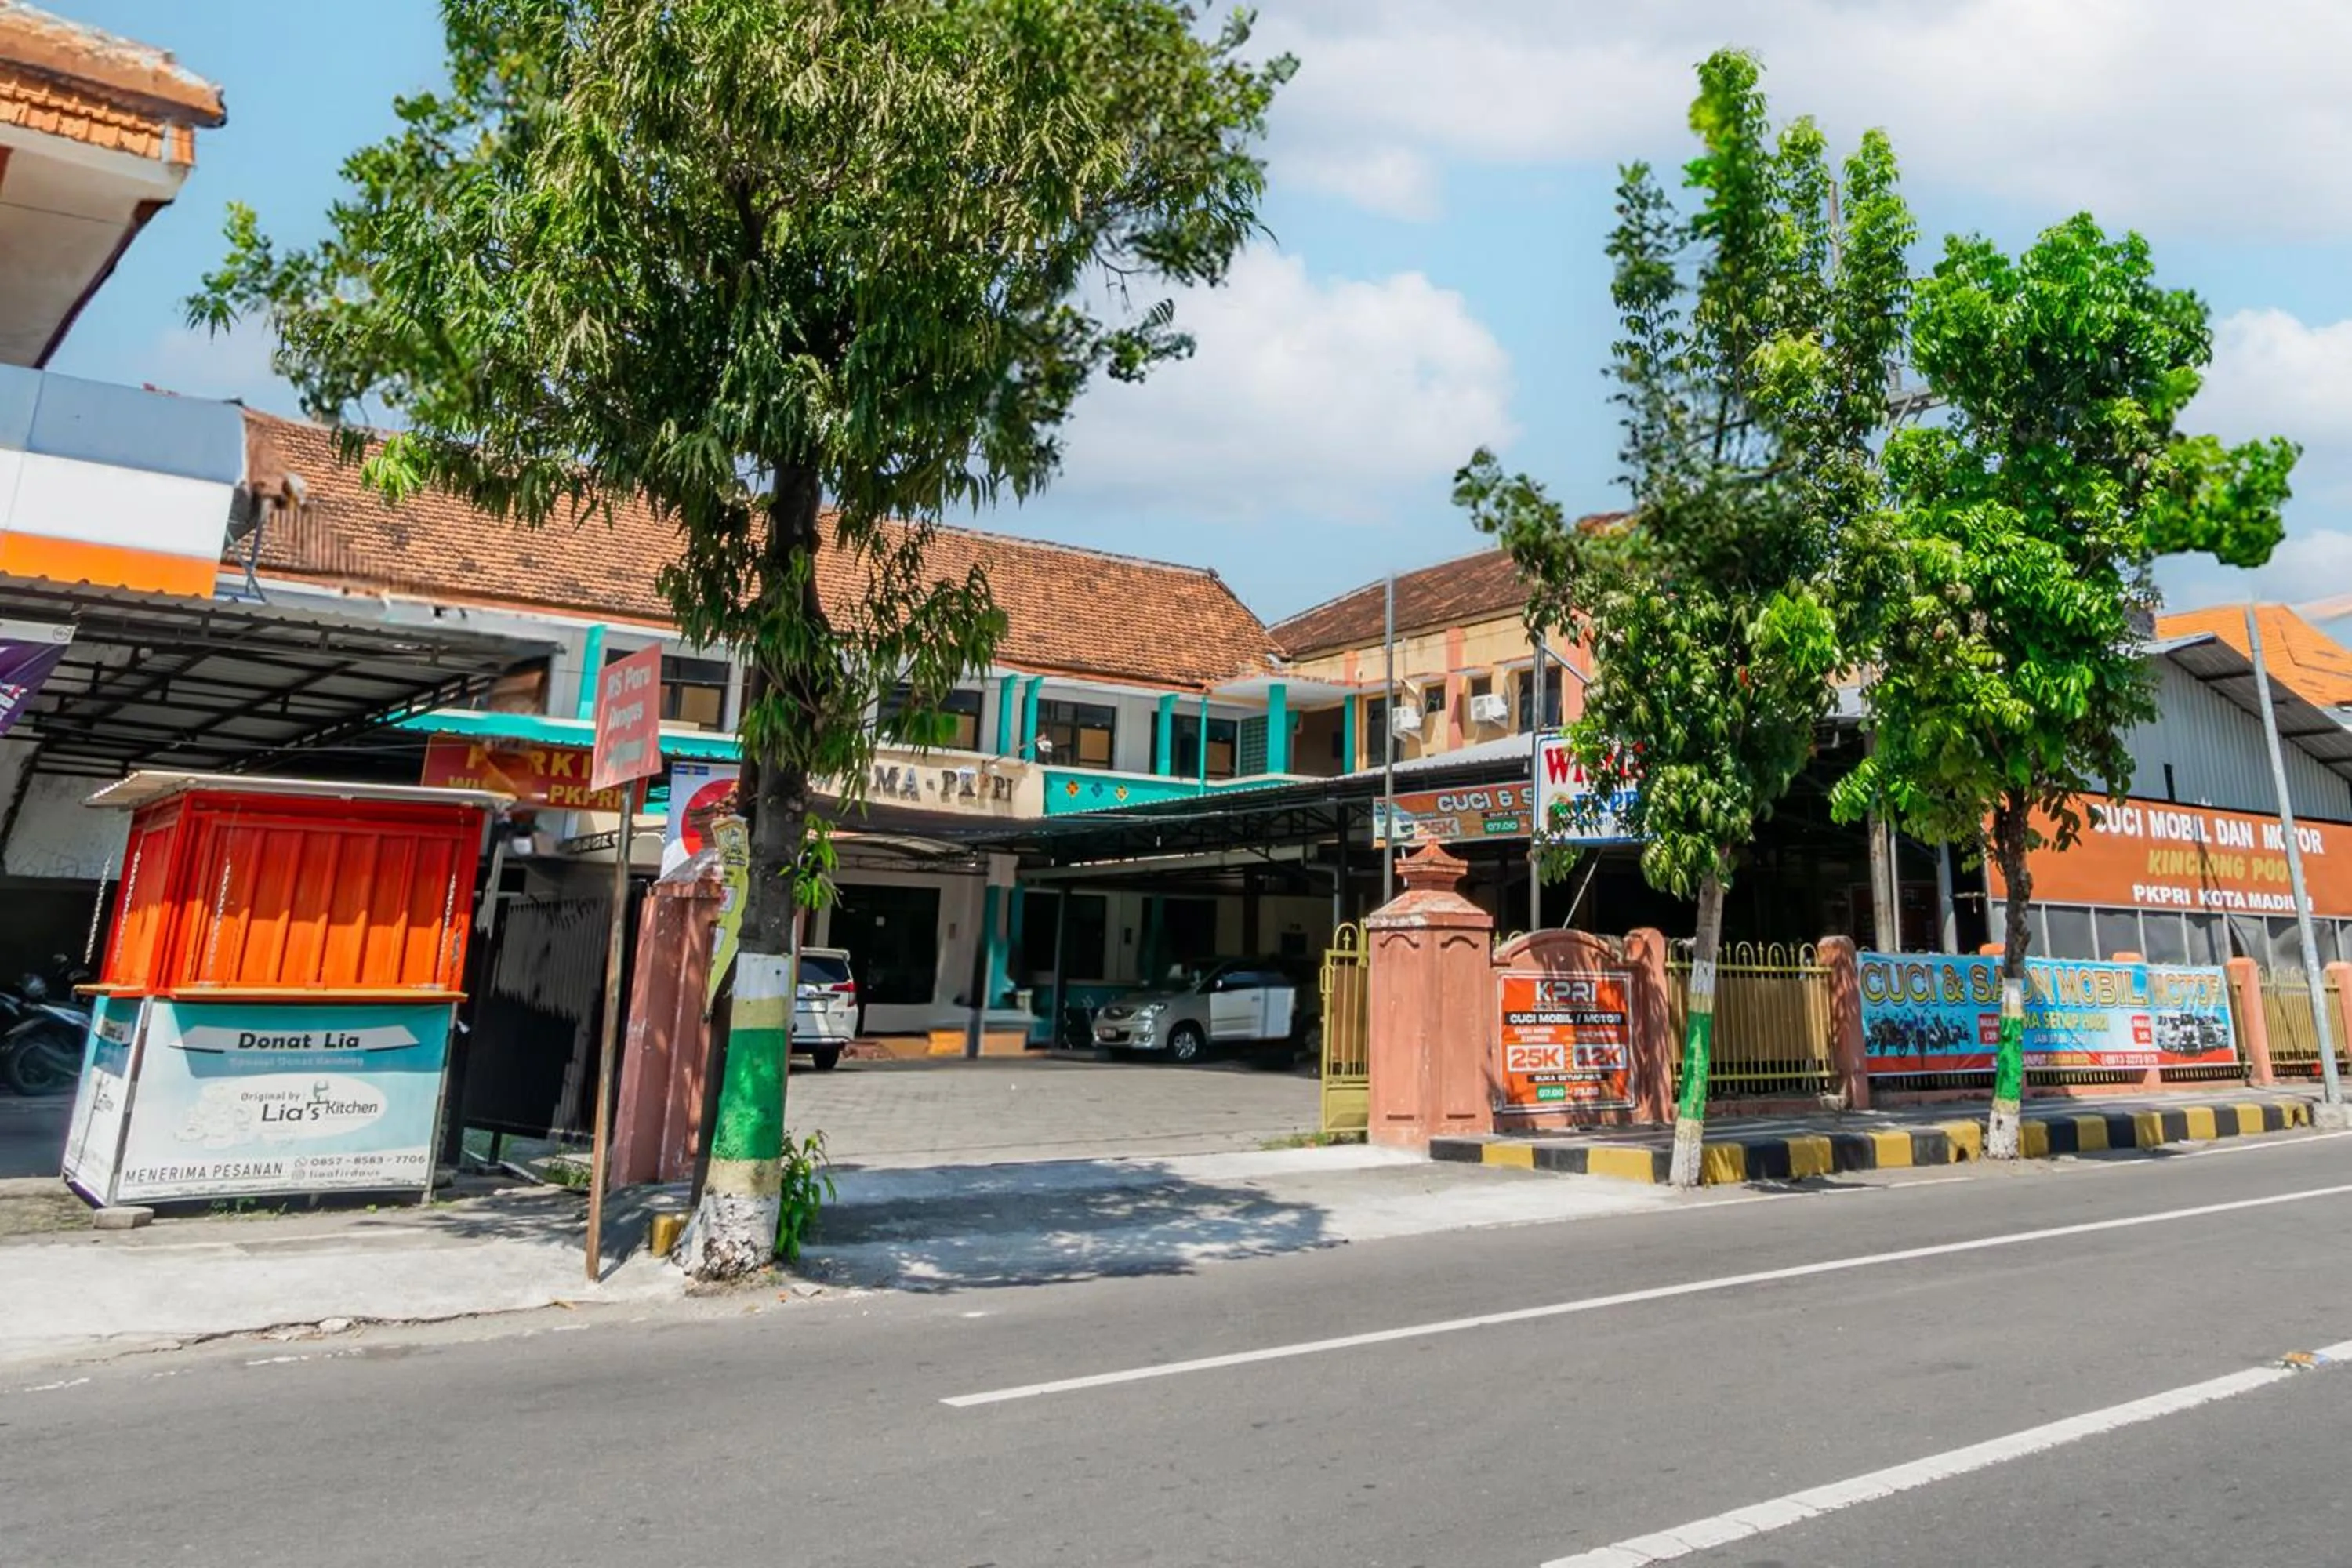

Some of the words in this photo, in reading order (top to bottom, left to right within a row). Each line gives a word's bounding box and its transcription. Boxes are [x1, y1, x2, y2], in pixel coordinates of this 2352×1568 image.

[1438, 792, 1493, 812] CUCI
[1497, 789, 1513, 807] &
[2092, 804, 2143, 839] CUCI
[2148, 808, 2211, 845] MOBIL
[2215, 818, 2254, 849] DAN
[2263, 823, 2325, 855] MOOR
[2132, 884, 2191, 906] PKPRI
[2198, 888, 2246, 909] KOTA
[1535, 981, 1596, 1003] KPRI
[1860, 961, 1936, 1007] CUCI
[1942, 962, 1966, 1004] &
[2056, 966, 2149, 1009] MOBIL
[1510, 1014, 1537, 1024] CUCI
[1538, 1014, 1574, 1024] MOBIL
[1584, 1014, 1622, 1024] MOTOR
[238, 1033, 311, 1050] Donat
[323, 1033, 360, 1049] Lia
[1511, 1047, 1561, 1069] 25K
[1576, 1047, 1621, 1069] 12K
[241, 1092, 285, 1102] Original
[262, 1102, 320, 1122] Lia's
[325, 1100, 378, 1114] Kitchen
[125, 1166, 207, 1183] MENERIMA
[212, 1161, 284, 1177] PESANAN
